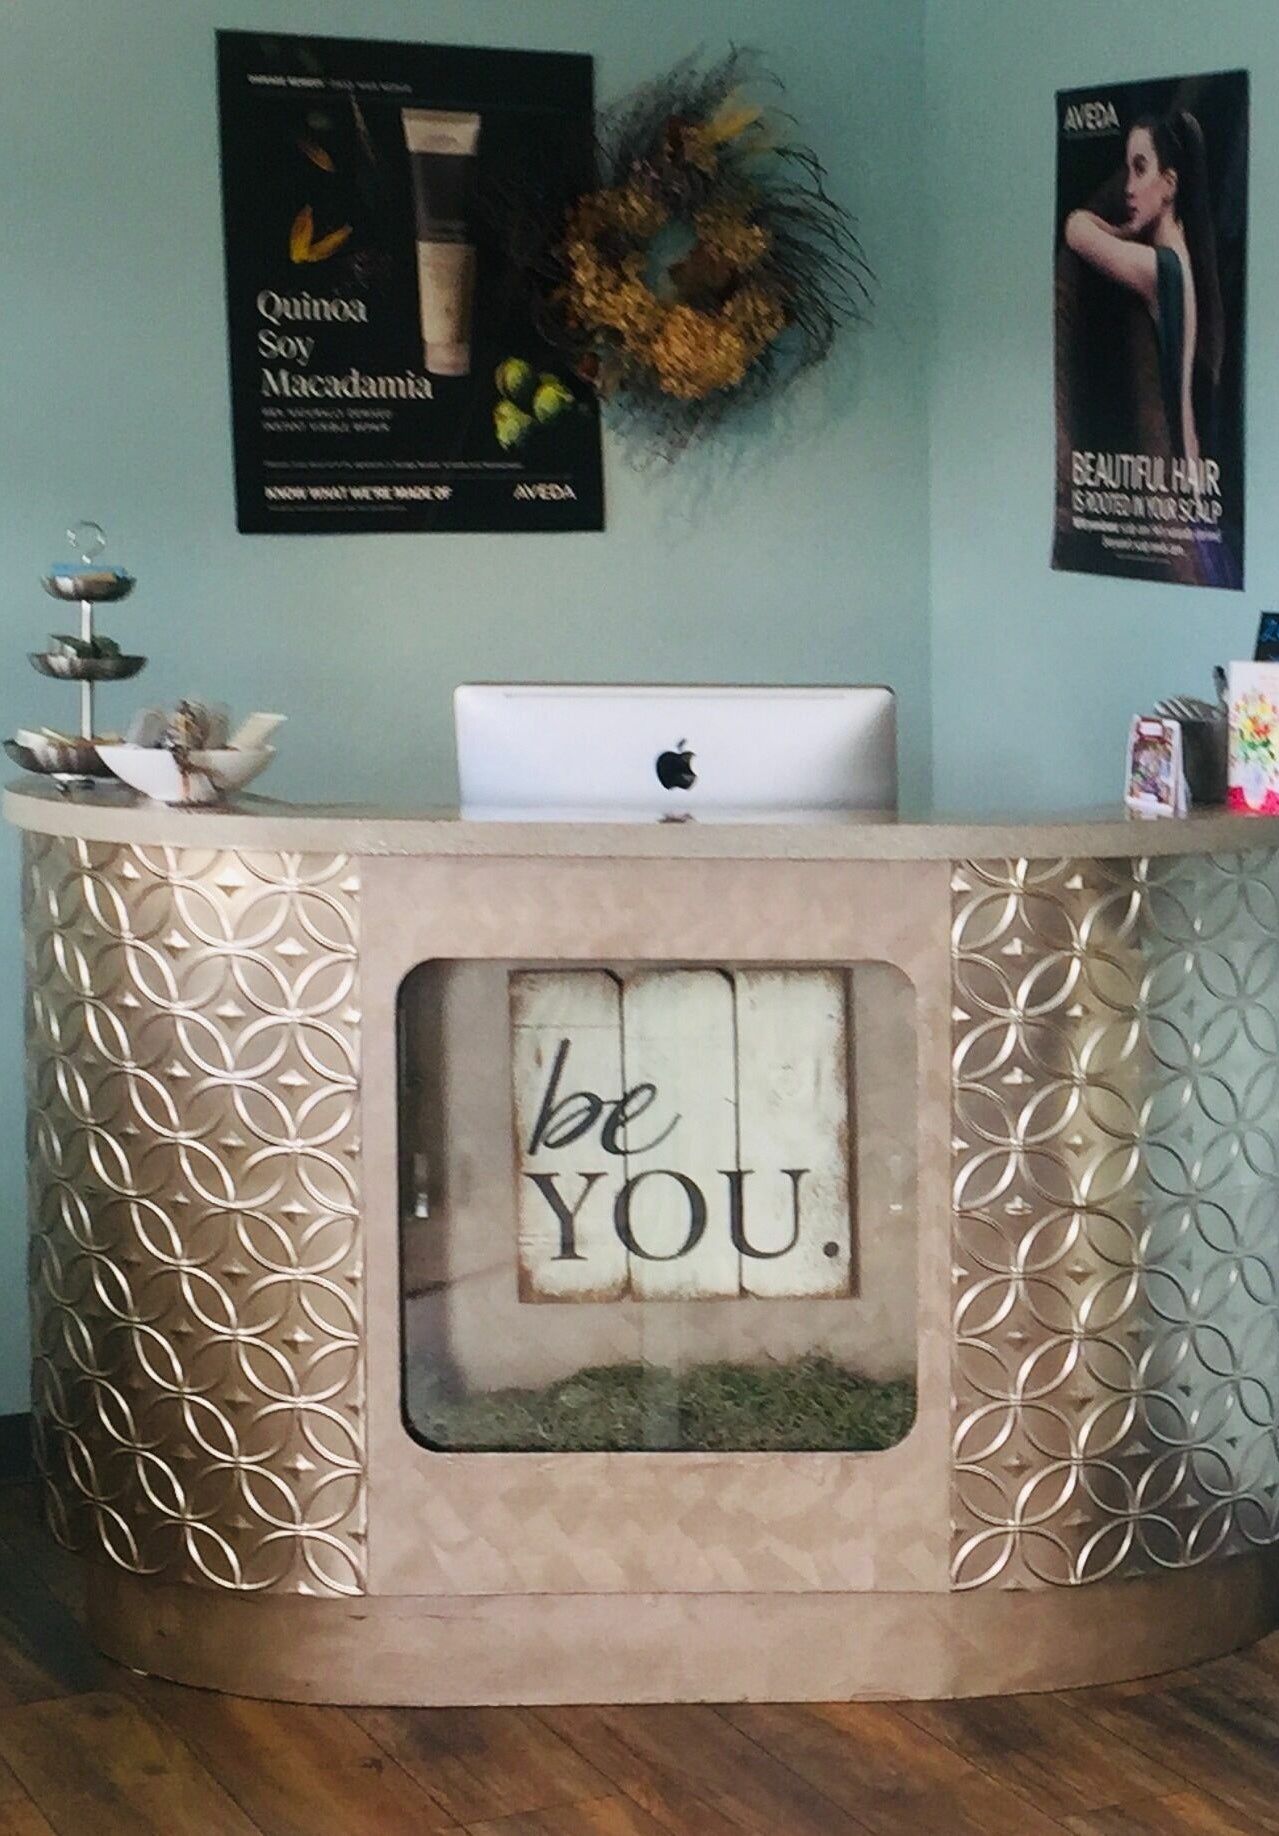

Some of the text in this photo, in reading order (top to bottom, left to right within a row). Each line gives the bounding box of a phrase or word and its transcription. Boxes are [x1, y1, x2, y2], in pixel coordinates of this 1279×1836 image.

[1062, 101, 1120, 131] AVEDA
[257, 289, 368, 326] Quinoa
[257, 328, 315, 366] Soy
[260, 367, 434, 400] Macadamia
[512, 482, 578, 501] AVEDA
[1071, 450, 1222, 498] BEAUTIFUL HAIR
[526, 1037, 683, 1157] be
[520, 1167, 841, 1262] YOU.
